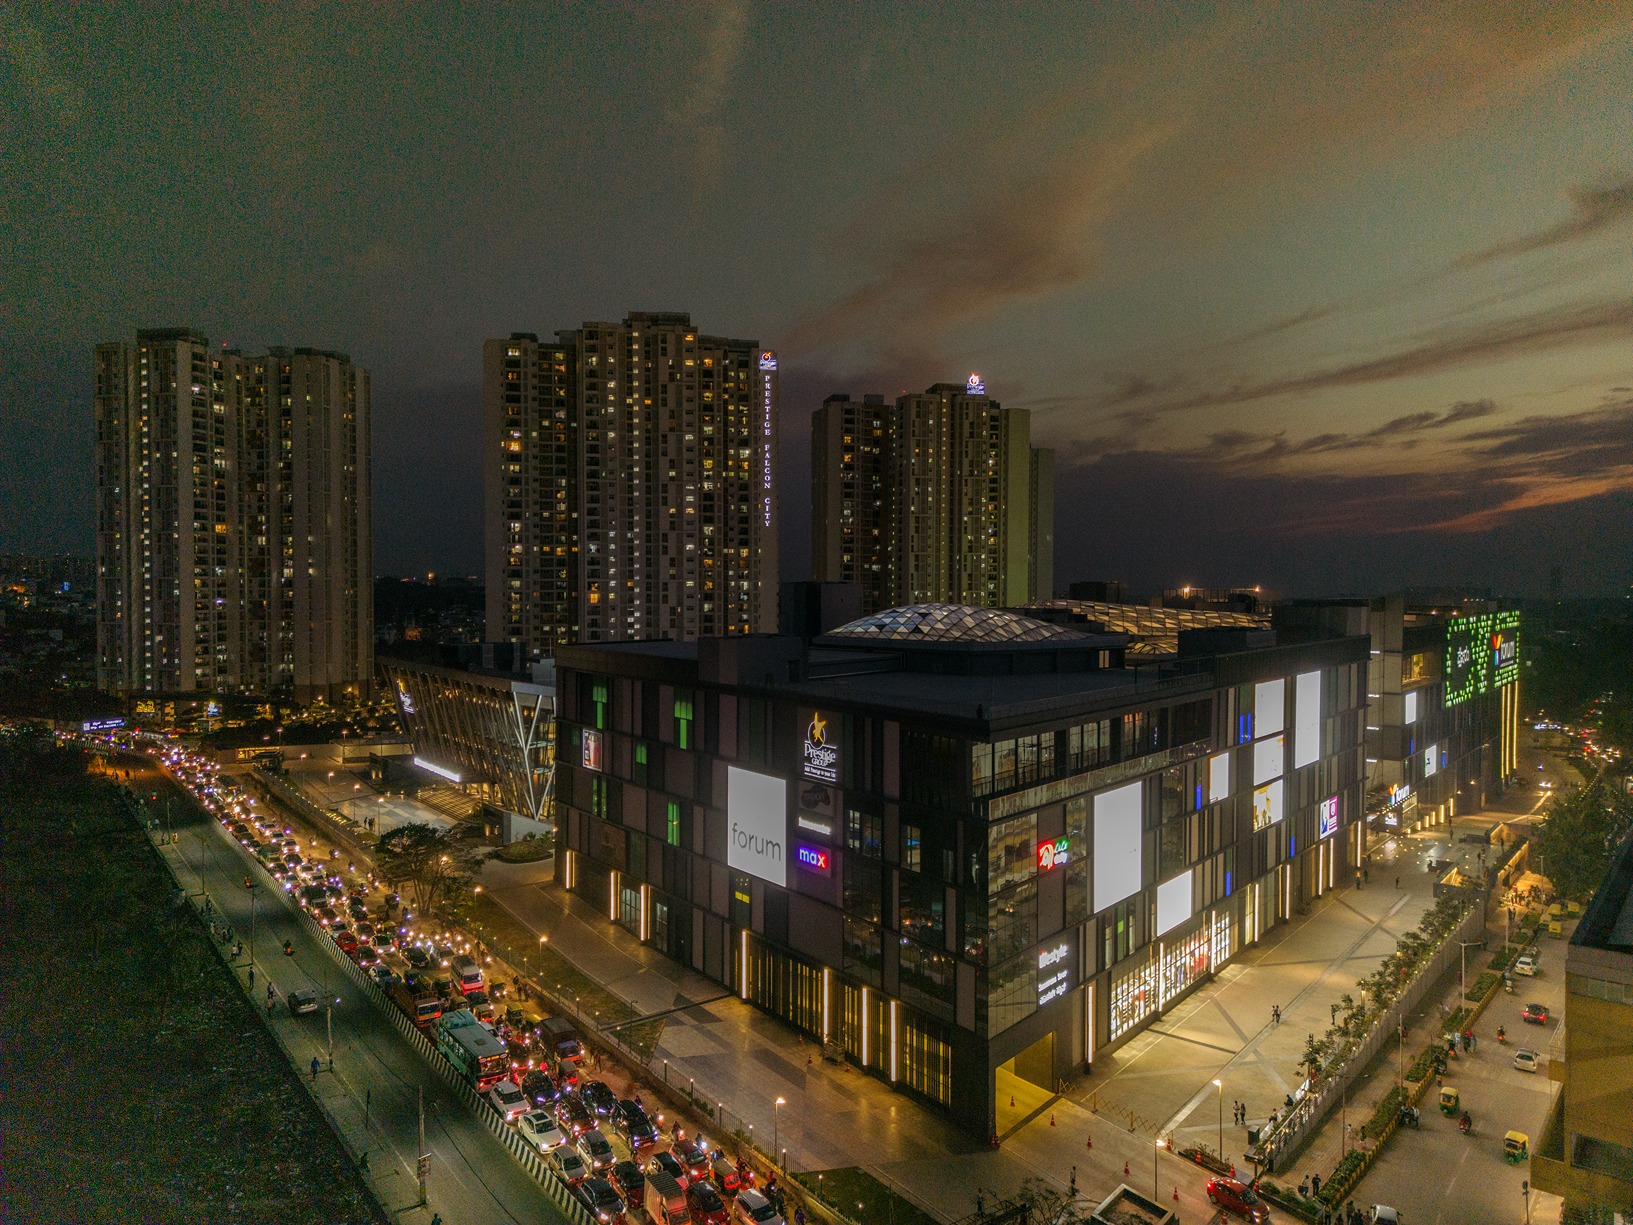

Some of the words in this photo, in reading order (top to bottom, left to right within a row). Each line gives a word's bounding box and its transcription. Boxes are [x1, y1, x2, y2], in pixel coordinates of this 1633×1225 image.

[804, 743, 836, 764] Prestige
[811, 757, 828, 767] GROUP
[731, 822, 782, 862] forum
[799, 848, 826, 869] max
